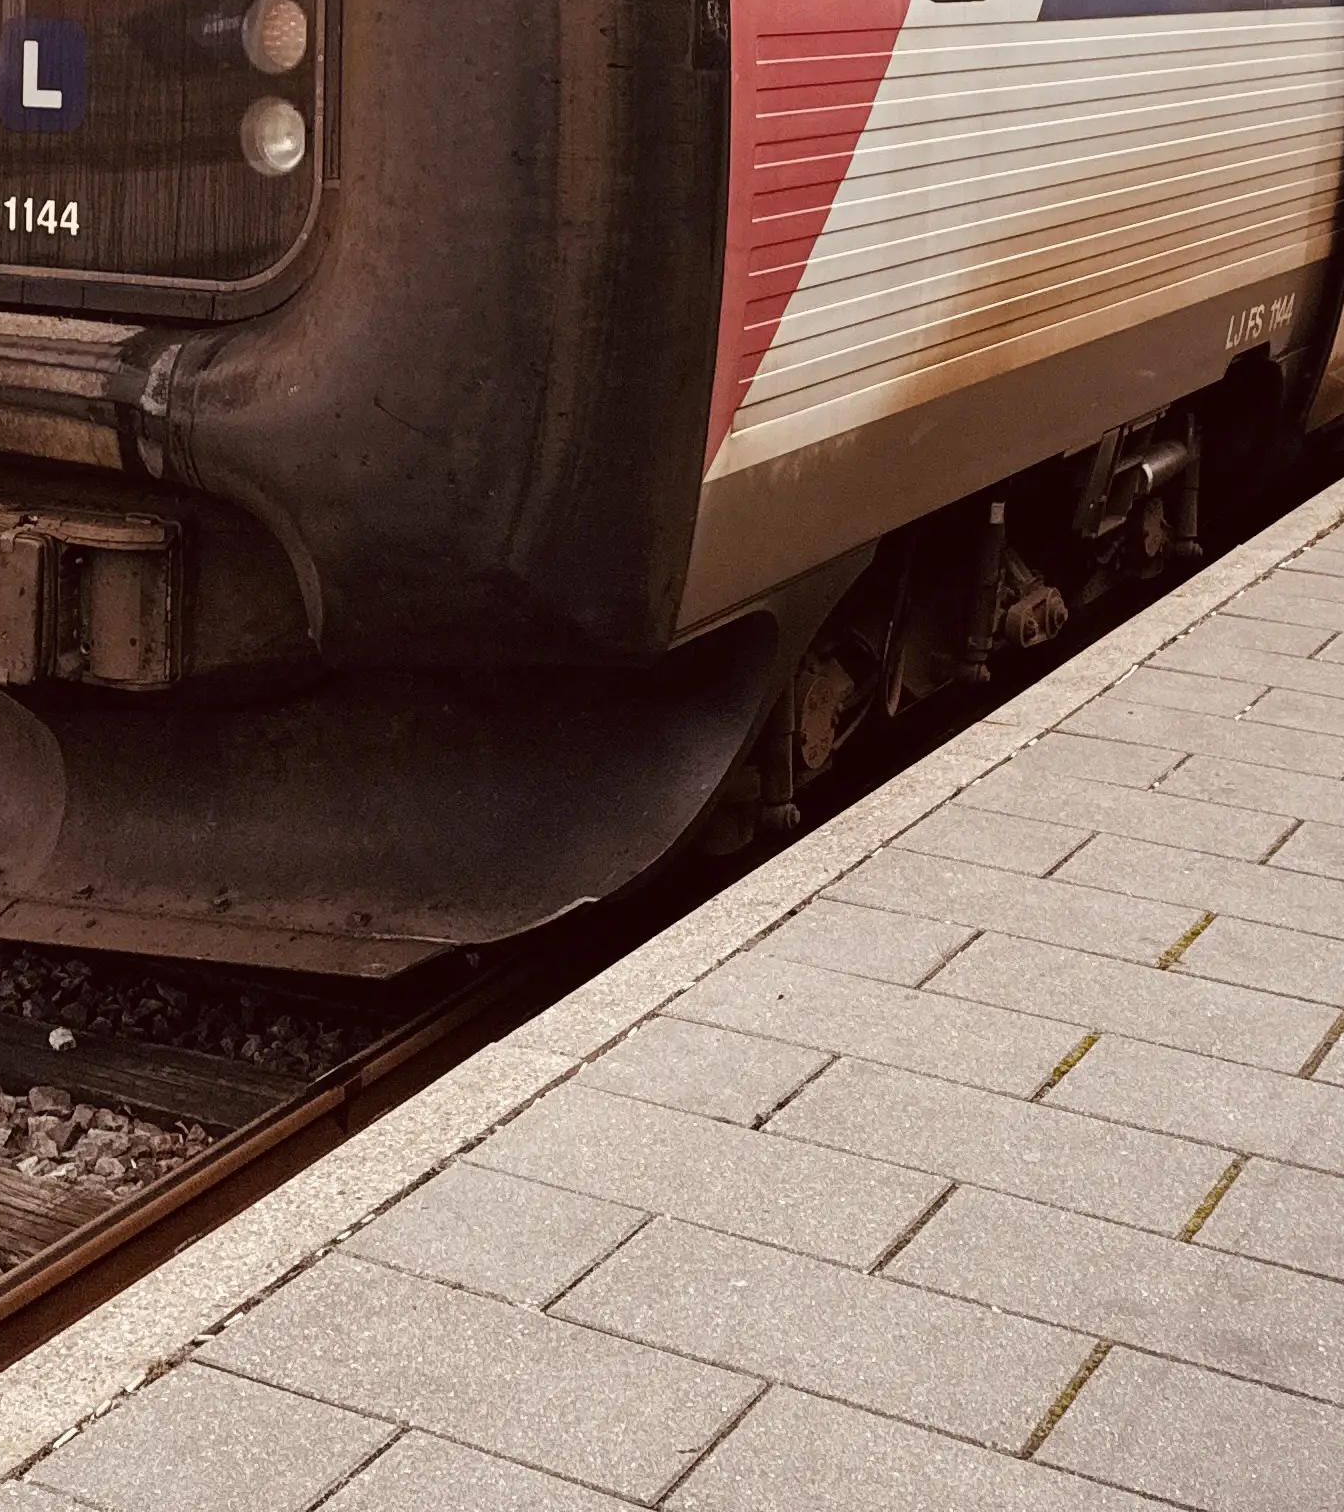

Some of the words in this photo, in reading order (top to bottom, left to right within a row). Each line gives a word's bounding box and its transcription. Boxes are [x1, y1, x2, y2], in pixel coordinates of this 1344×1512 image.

[22, 40, 63, 110] L
[4, 196, 80, 236] 1144
[1269, 292, 1295, 332] 1144
